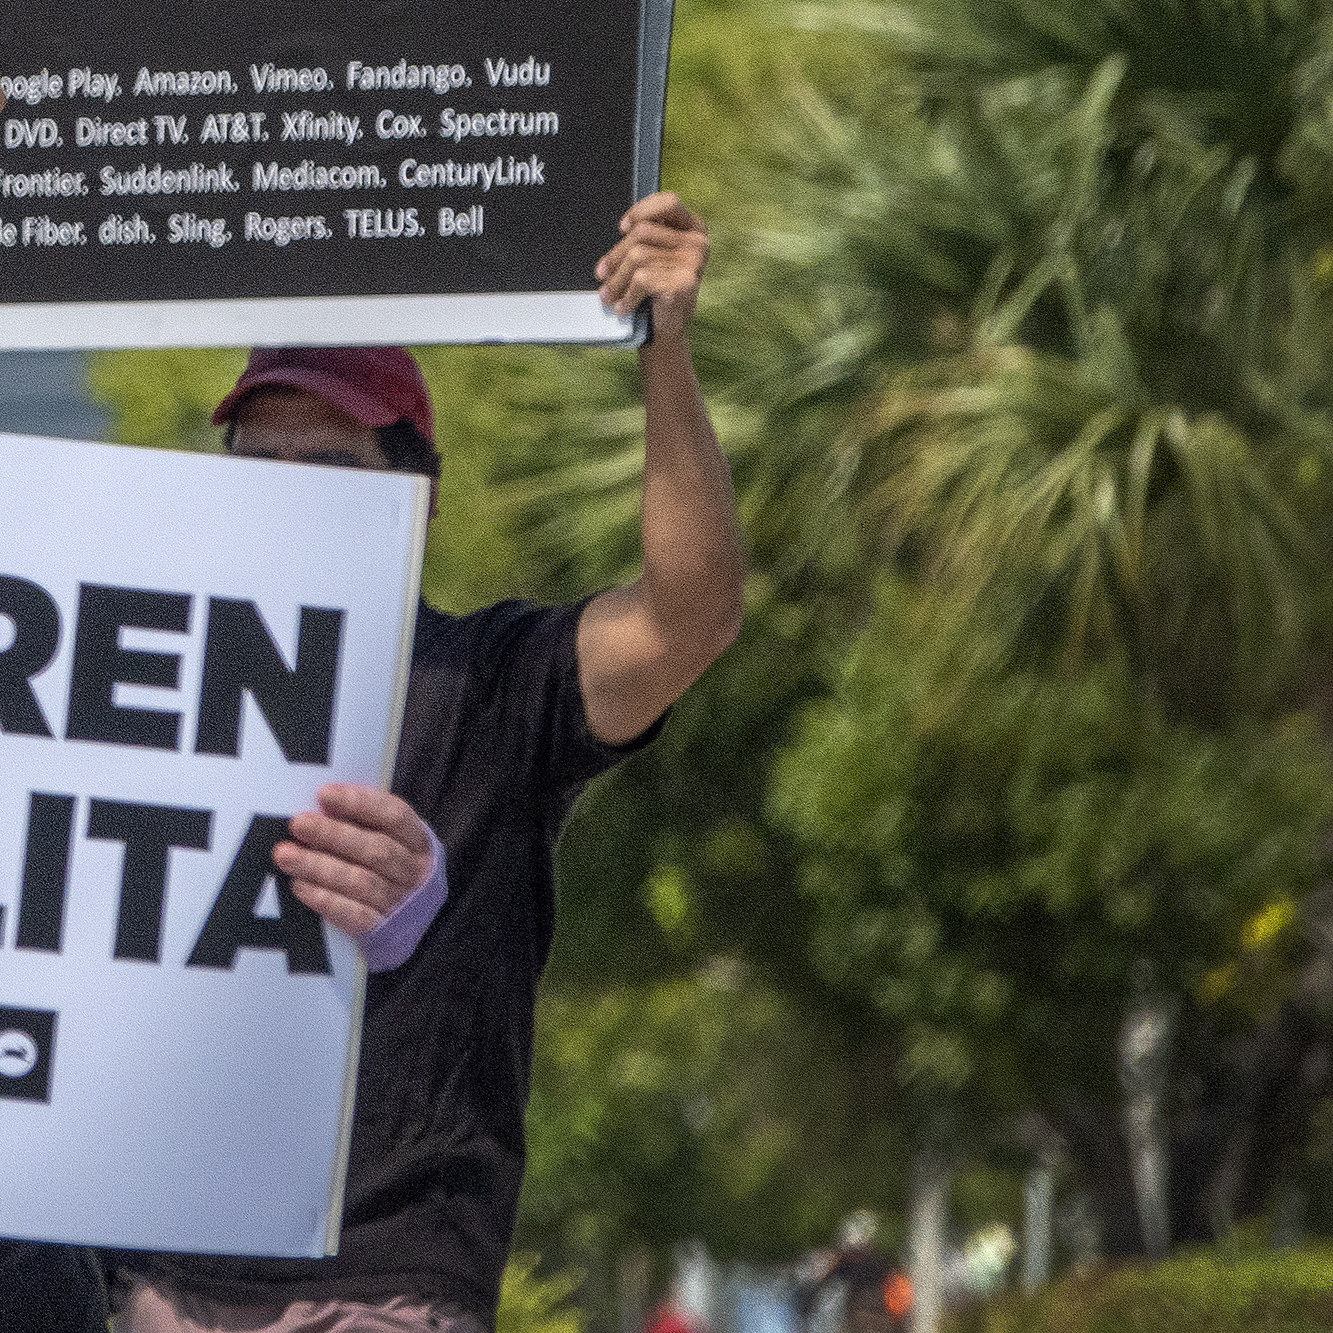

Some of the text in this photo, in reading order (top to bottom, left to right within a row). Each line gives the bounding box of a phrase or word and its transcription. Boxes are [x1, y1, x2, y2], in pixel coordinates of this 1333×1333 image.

[484, 55, 551, 88] Vudu
[75, 116, 148, 146] Direct
[440, 107, 559, 144] Spectrum
[398, 153, 545, 193] CenturyLink
[438, 205, 483, 237] Bell
